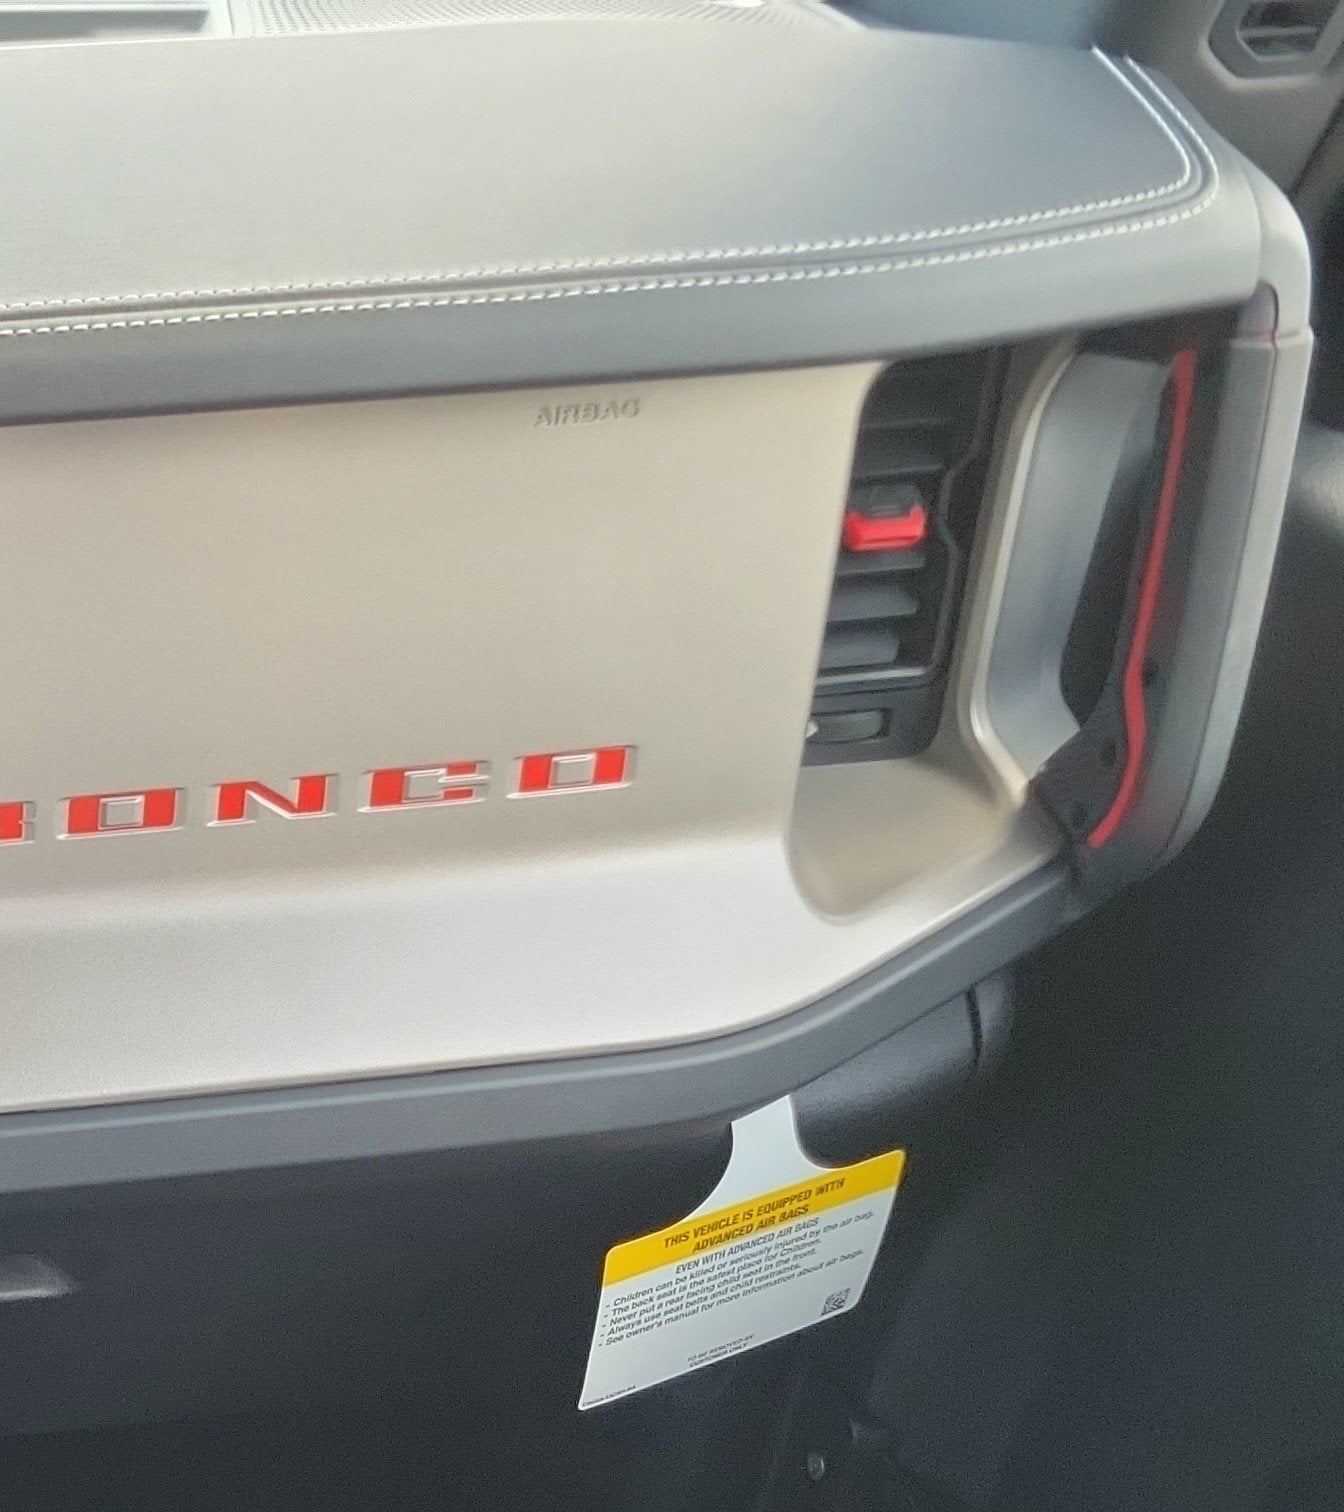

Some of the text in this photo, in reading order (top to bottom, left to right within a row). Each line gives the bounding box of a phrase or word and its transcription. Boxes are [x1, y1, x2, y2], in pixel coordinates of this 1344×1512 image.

[664, 1178, 846, 1248] THIS VEHICLE IS EQUIPPED WITH
[692, 1204, 810, 1252] ADVANCED AIR BAGS
[614, 1286, 654, 1306] Children
[656, 1280, 673, 1292] can
[675, 1274, 687, 1284] be
[690, 1266, 715, 1280] killed
[729, 1244, 772, 1265] seriously
[774, 1232, 808, 1250] injured
[675, 1217, 820, 1274] EVEN WITH ADVANCED AIR BAGS
[606, 1334, 624, 1346] See
[626, 1322, 662, 1338] owner's
[664, 1308, 700, 1326] manual
[716, 1292, 741, 1306] more
[742, 1273, 796, 1298] information
[607, 1320, 642, 1336] Always
[663, 1304, 684, 1317] seat
[686, 1296, 708, 1309] belts
[710, 1288, 728, 1300] and
[730, 1278, 753, 1292] child
[610, 1311, 638, 1326] Never
[639, 1306, 656, 1320] put
[665, 1296, 685, 1308] rear
[686, 1286, 716, 1300] facing
[716, 1274, 741, 1288] child
[742, 1267, 763, 1280] seat
[612, 1306, 630, 1318] The
[632, 1296, 654, 1310] back
[656, 1290, 677, 1301] seat
[690, 1280, 705, 1290] the
[706, 1268, 736, 1282] safest
[737, 1258, 763, 1274] place
